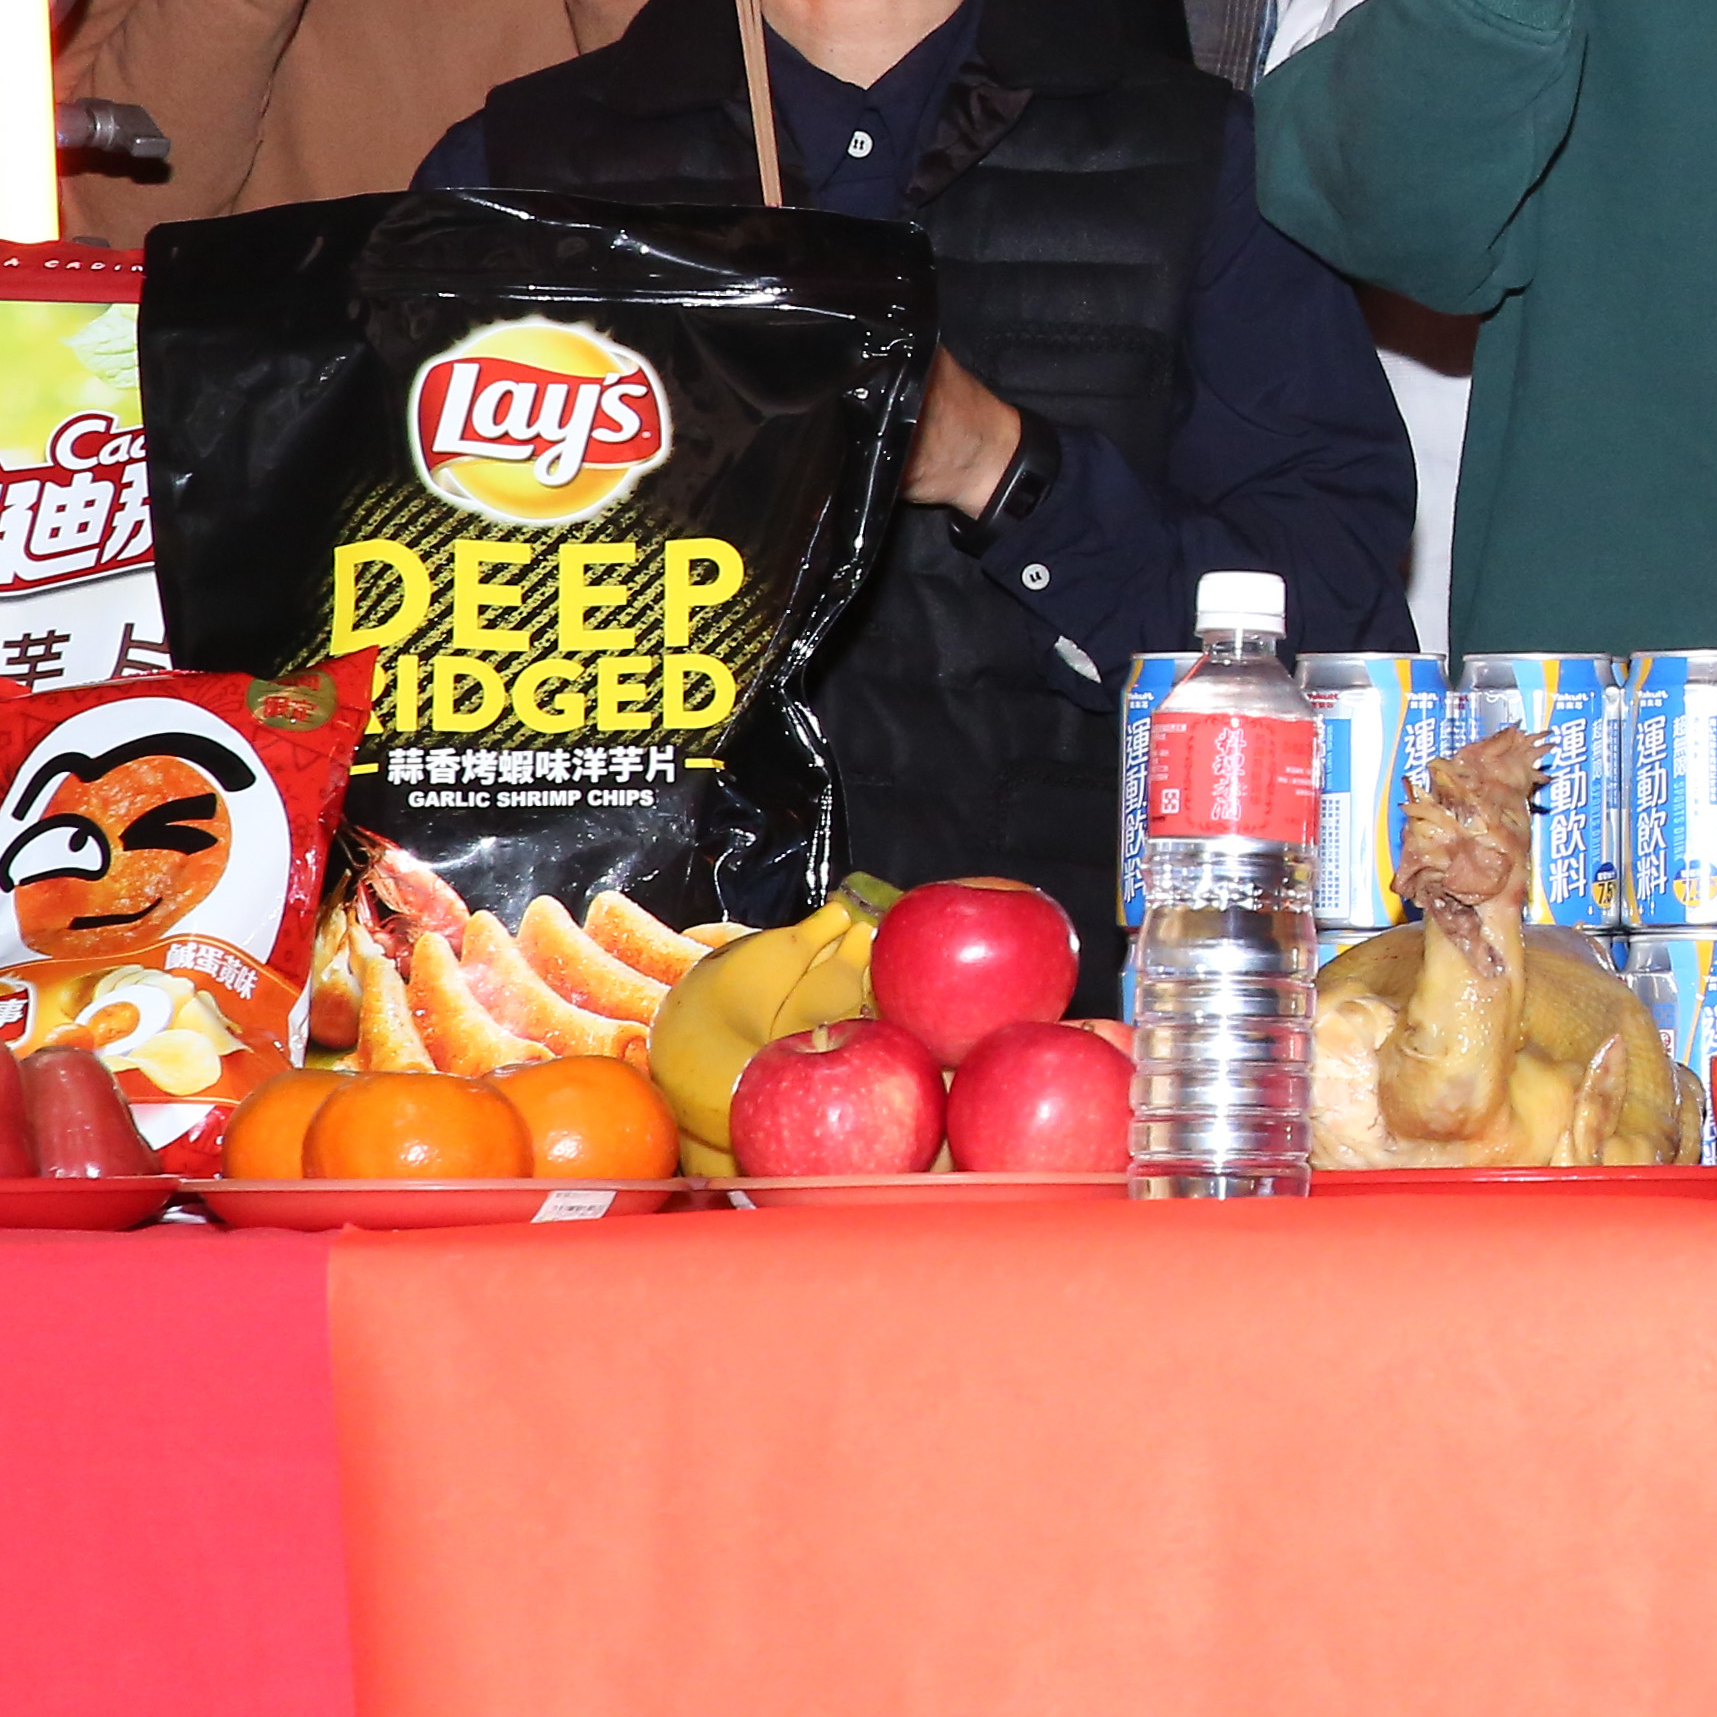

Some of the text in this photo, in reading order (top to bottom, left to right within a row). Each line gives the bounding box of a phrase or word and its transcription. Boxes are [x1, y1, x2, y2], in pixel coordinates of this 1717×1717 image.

[431, 361, 649, 487] Lay's
[330, 537, 746, 656] DEEP
[387, 745, 677, 786] 蒜香烤蝦味洋芋片
[408, 787, 655, 809] GARLIC SHRIMP CHIPS
[1549, 716, 1588, 904] 運動飲料
[1636, 715, 1669, 901] 運動飲料
[163, 941, 258, 1000] 鹹蛋黃味
